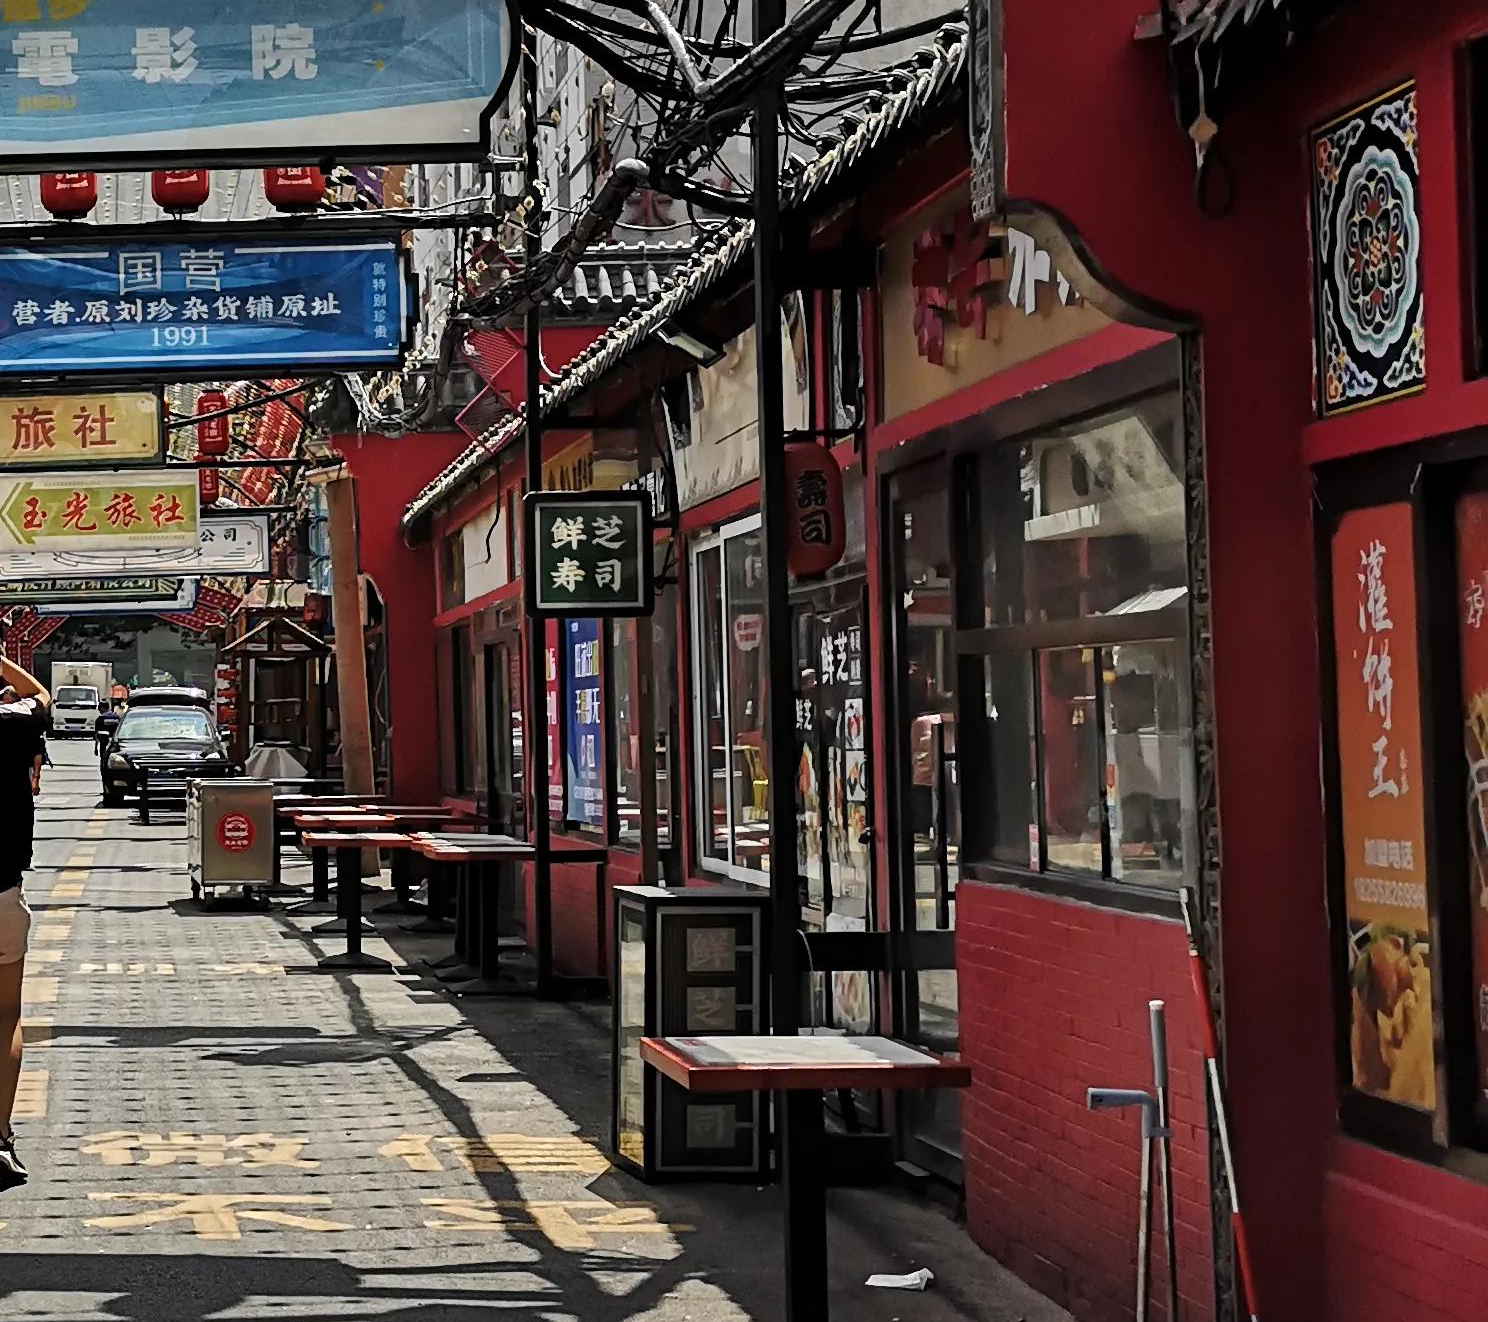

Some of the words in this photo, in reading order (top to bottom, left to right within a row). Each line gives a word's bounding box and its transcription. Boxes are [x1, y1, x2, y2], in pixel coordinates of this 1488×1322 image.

[118, 247, 225, 296] 国营
[150, 325, 211, 348] 1991
[22, 492, 186, 532] 玉光旅社
[200, 527, 238, 543] 公司
[550, 515, 627, 552] 鲜芝
[550, 557, 624, 593] 寿司
[1358, 539, 1398, 799] 灌饼王
